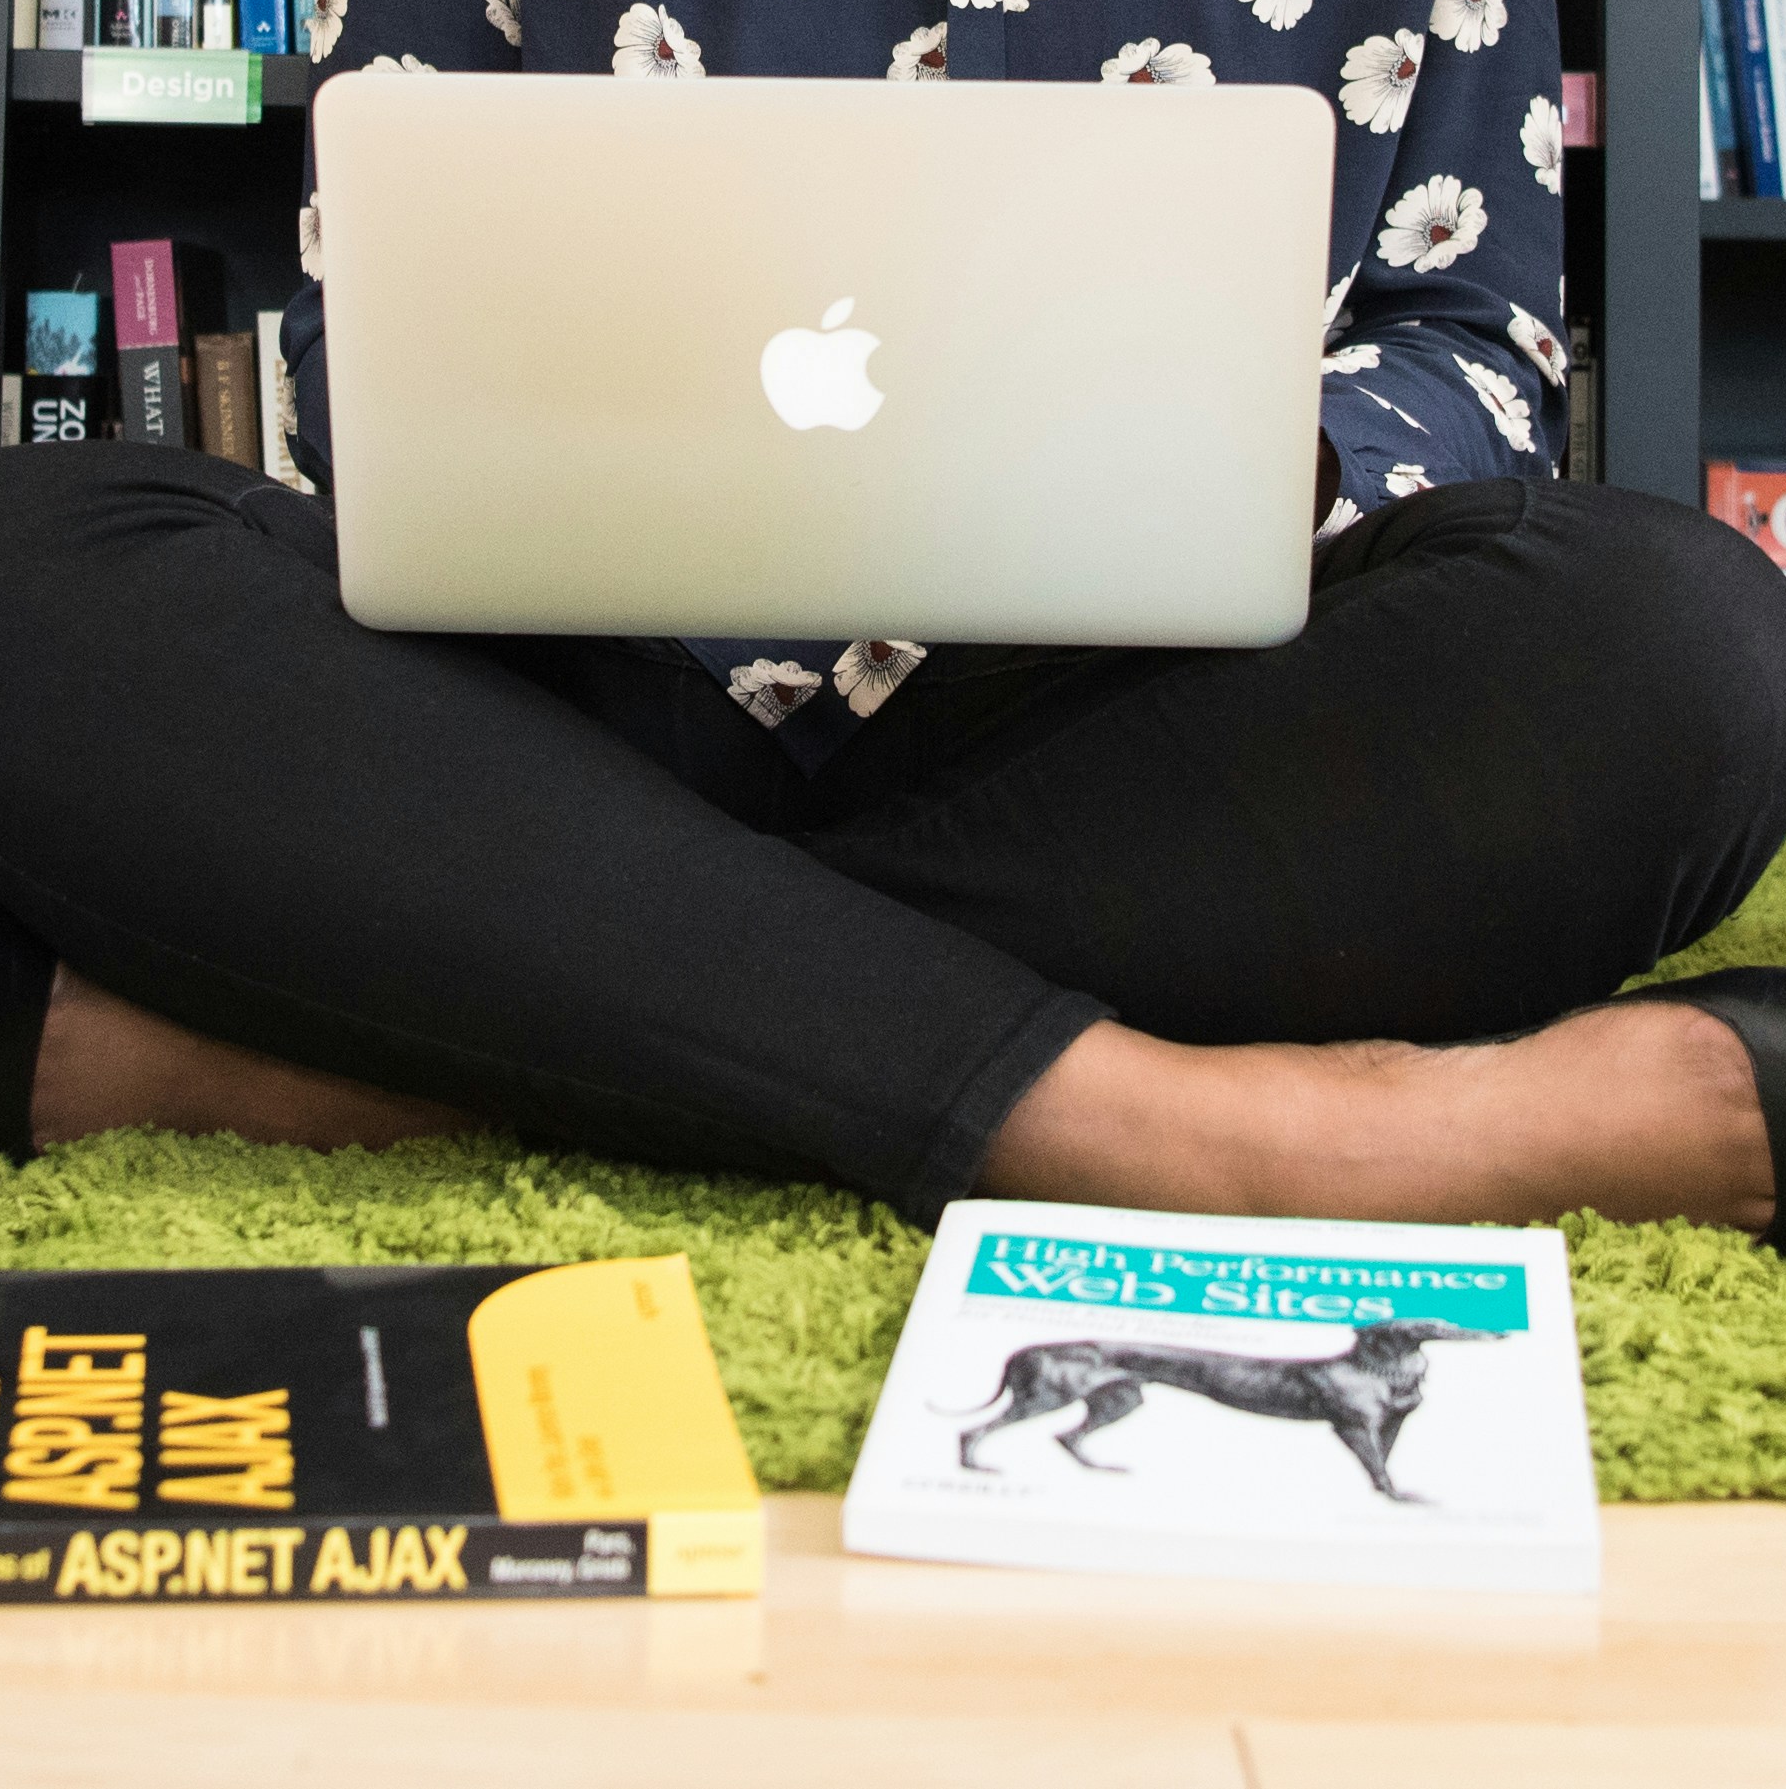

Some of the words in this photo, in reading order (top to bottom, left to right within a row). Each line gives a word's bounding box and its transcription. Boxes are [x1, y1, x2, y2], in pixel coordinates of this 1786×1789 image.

[121, 70, 235, 102] Design
[144, 360, 164, 437] WHAT
[987, 1259, 1176, 1309] Web
[1202, 1278, 1396, 1320] Sites
[992, 1235, 1128, 1272] High
[1149, 1248, 1508, 1291] Performance
[0, 1325, 148, 1511] ASP.NET
[155, 1389, 295, 1511] AJAX
[54, 1528, 307, 1598] ASP.NET
[309, 1525, 470, 1594] AJAX
